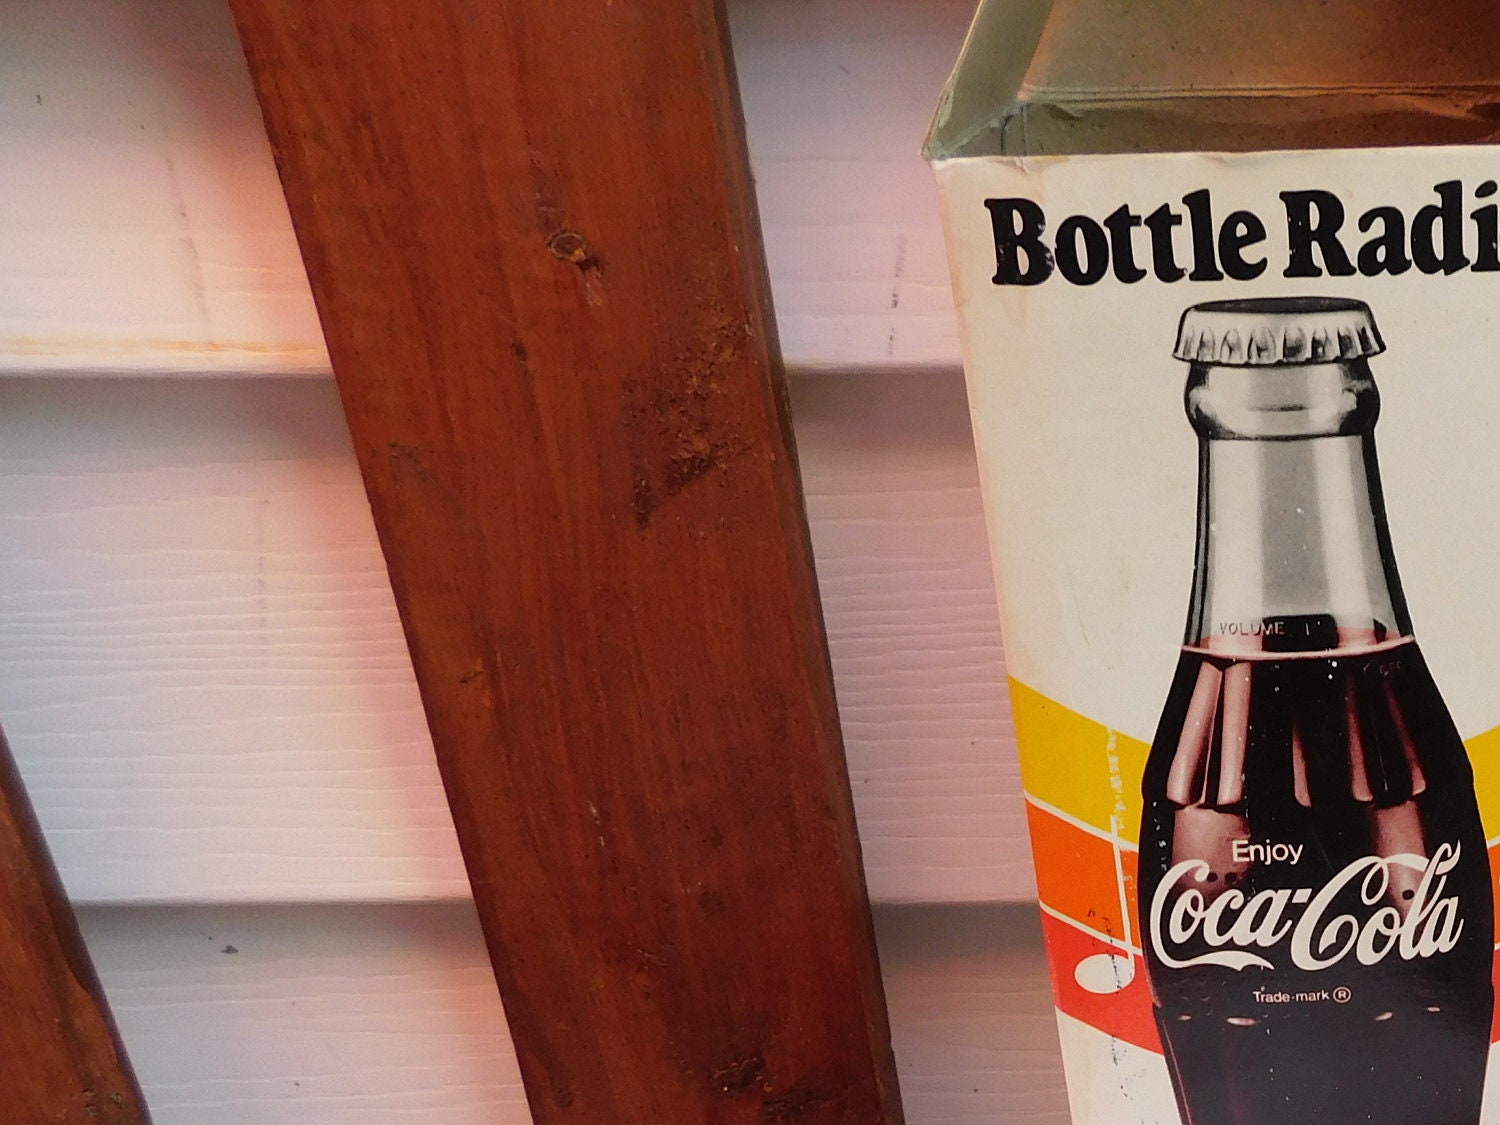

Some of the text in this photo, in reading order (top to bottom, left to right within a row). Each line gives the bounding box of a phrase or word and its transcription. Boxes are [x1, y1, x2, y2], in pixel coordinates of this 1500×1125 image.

[983, 188, 1268, 287] Bottle
[1219, 620, 1286, 637] VOLUME
[1232, 838, 1304, 865] Enjoy
[1149, 839, 1465, 971] Coca-Cola
